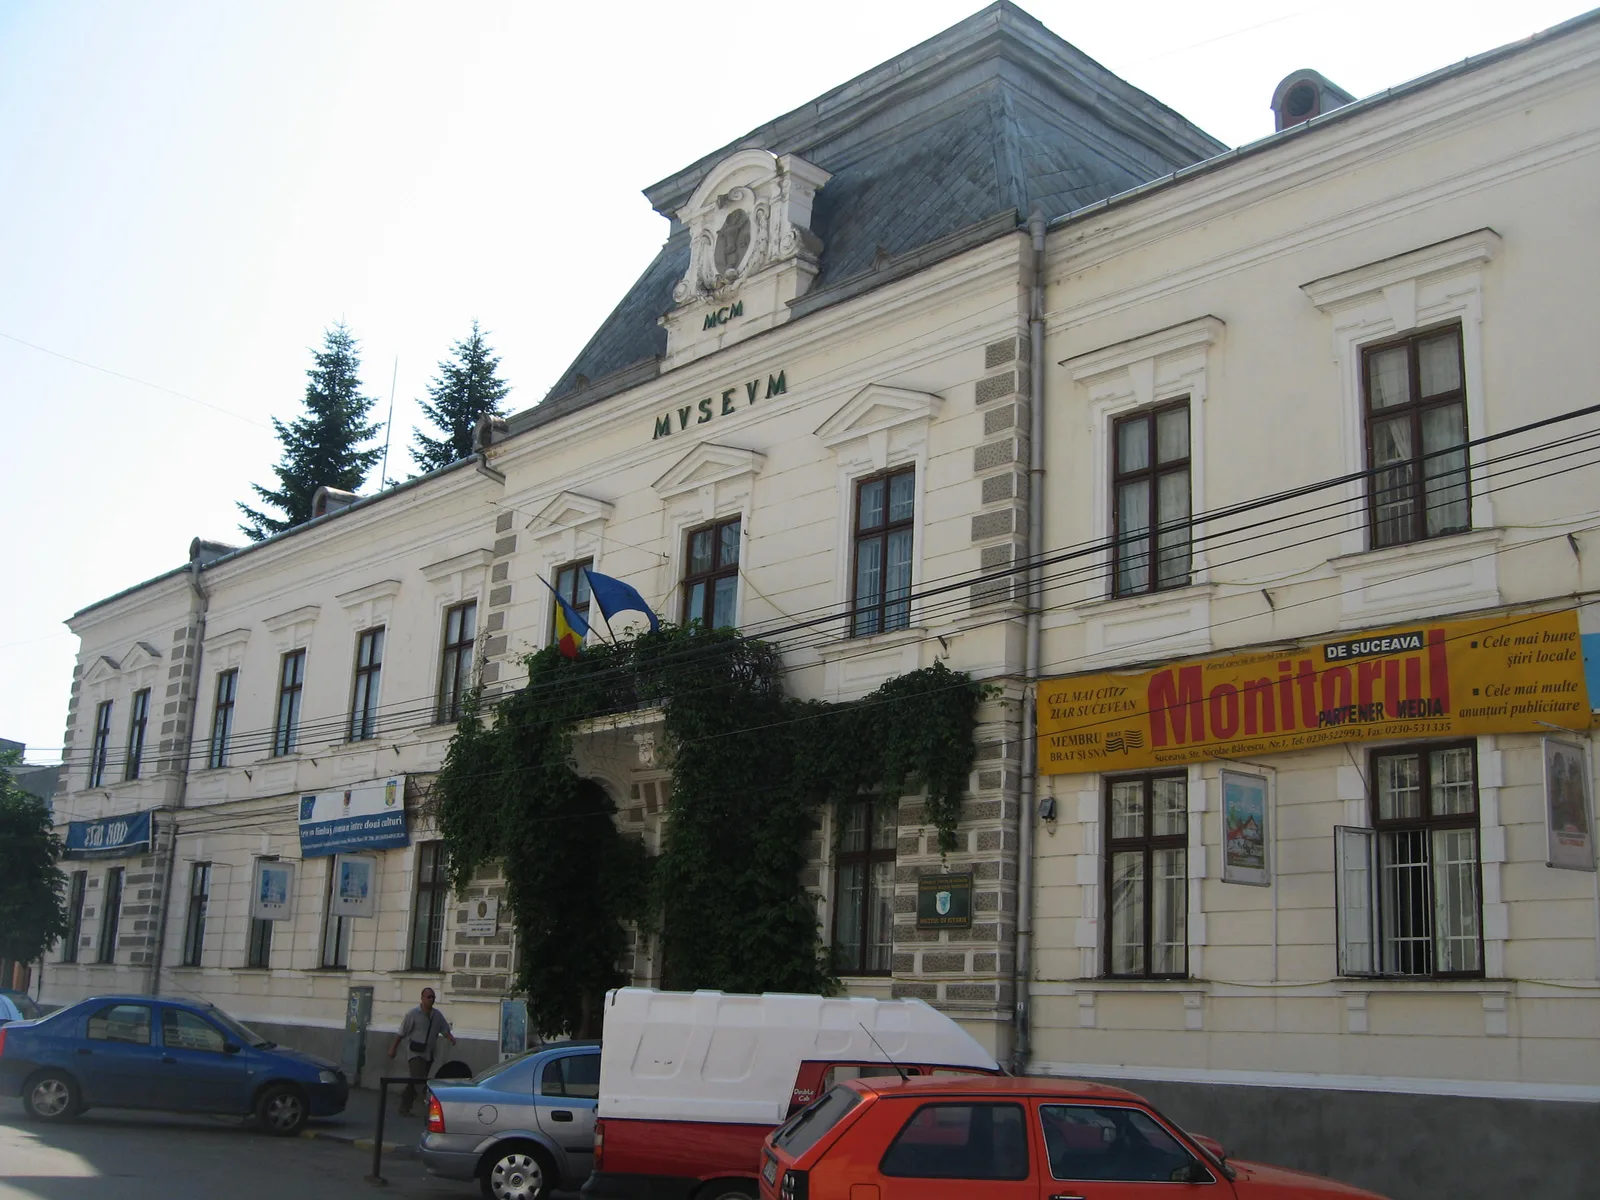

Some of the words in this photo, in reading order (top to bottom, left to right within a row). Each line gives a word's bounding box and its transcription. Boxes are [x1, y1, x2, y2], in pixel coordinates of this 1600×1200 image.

[702, 300, 743, 331] MCM
[652, 370, 787, 440] MVSEVM
[1327, 645, 1347, 659] DE
[1351, 635, 1421, 655] SUCEAVA
[1483, 634, 1511, 649] Cele
[1514, 632, 1540, 646] mai
[1542, 631, 1577, 643] bune
[1536, 648, 1577, 663] locale
[1048, 693, 1069, 705] CEL
[1071, 690, 1094, 702] MAI
[1096, 686, 1128, 699] CITIT
[1148, 629, 1450, 747] Monitorul
[1485, 683, 1511, 698] Cele
[1514, 680, 1538, 695] mai
[1541, 679, 1579, 693] multe
[1050, 706, 1075, 719] ZIAR
[1077, 700, 1137, 717] SUCEVEAN
[1318, 701, 1385, 728] PARTENER
[1396, 697, 1444, 719] MEDIA
[1510, 699, 1581, 718] publicitare
[1050, 732, 1102, 748] MEMBRU
[1202, 746, 1229, 757] Nicolae
[1291, 736, 1305, 746] Tel:
[1306, 728, 1364, 743] 0230-522993,
[1367, 727, 1383, 736] Fax:
[1385, 722, 1452, 734] 0230-531335
[1050, 750, 1075, 761] BRAT
[1088, 748, 1108, 759] SNA
[381, 815, 402, 828] culturi
